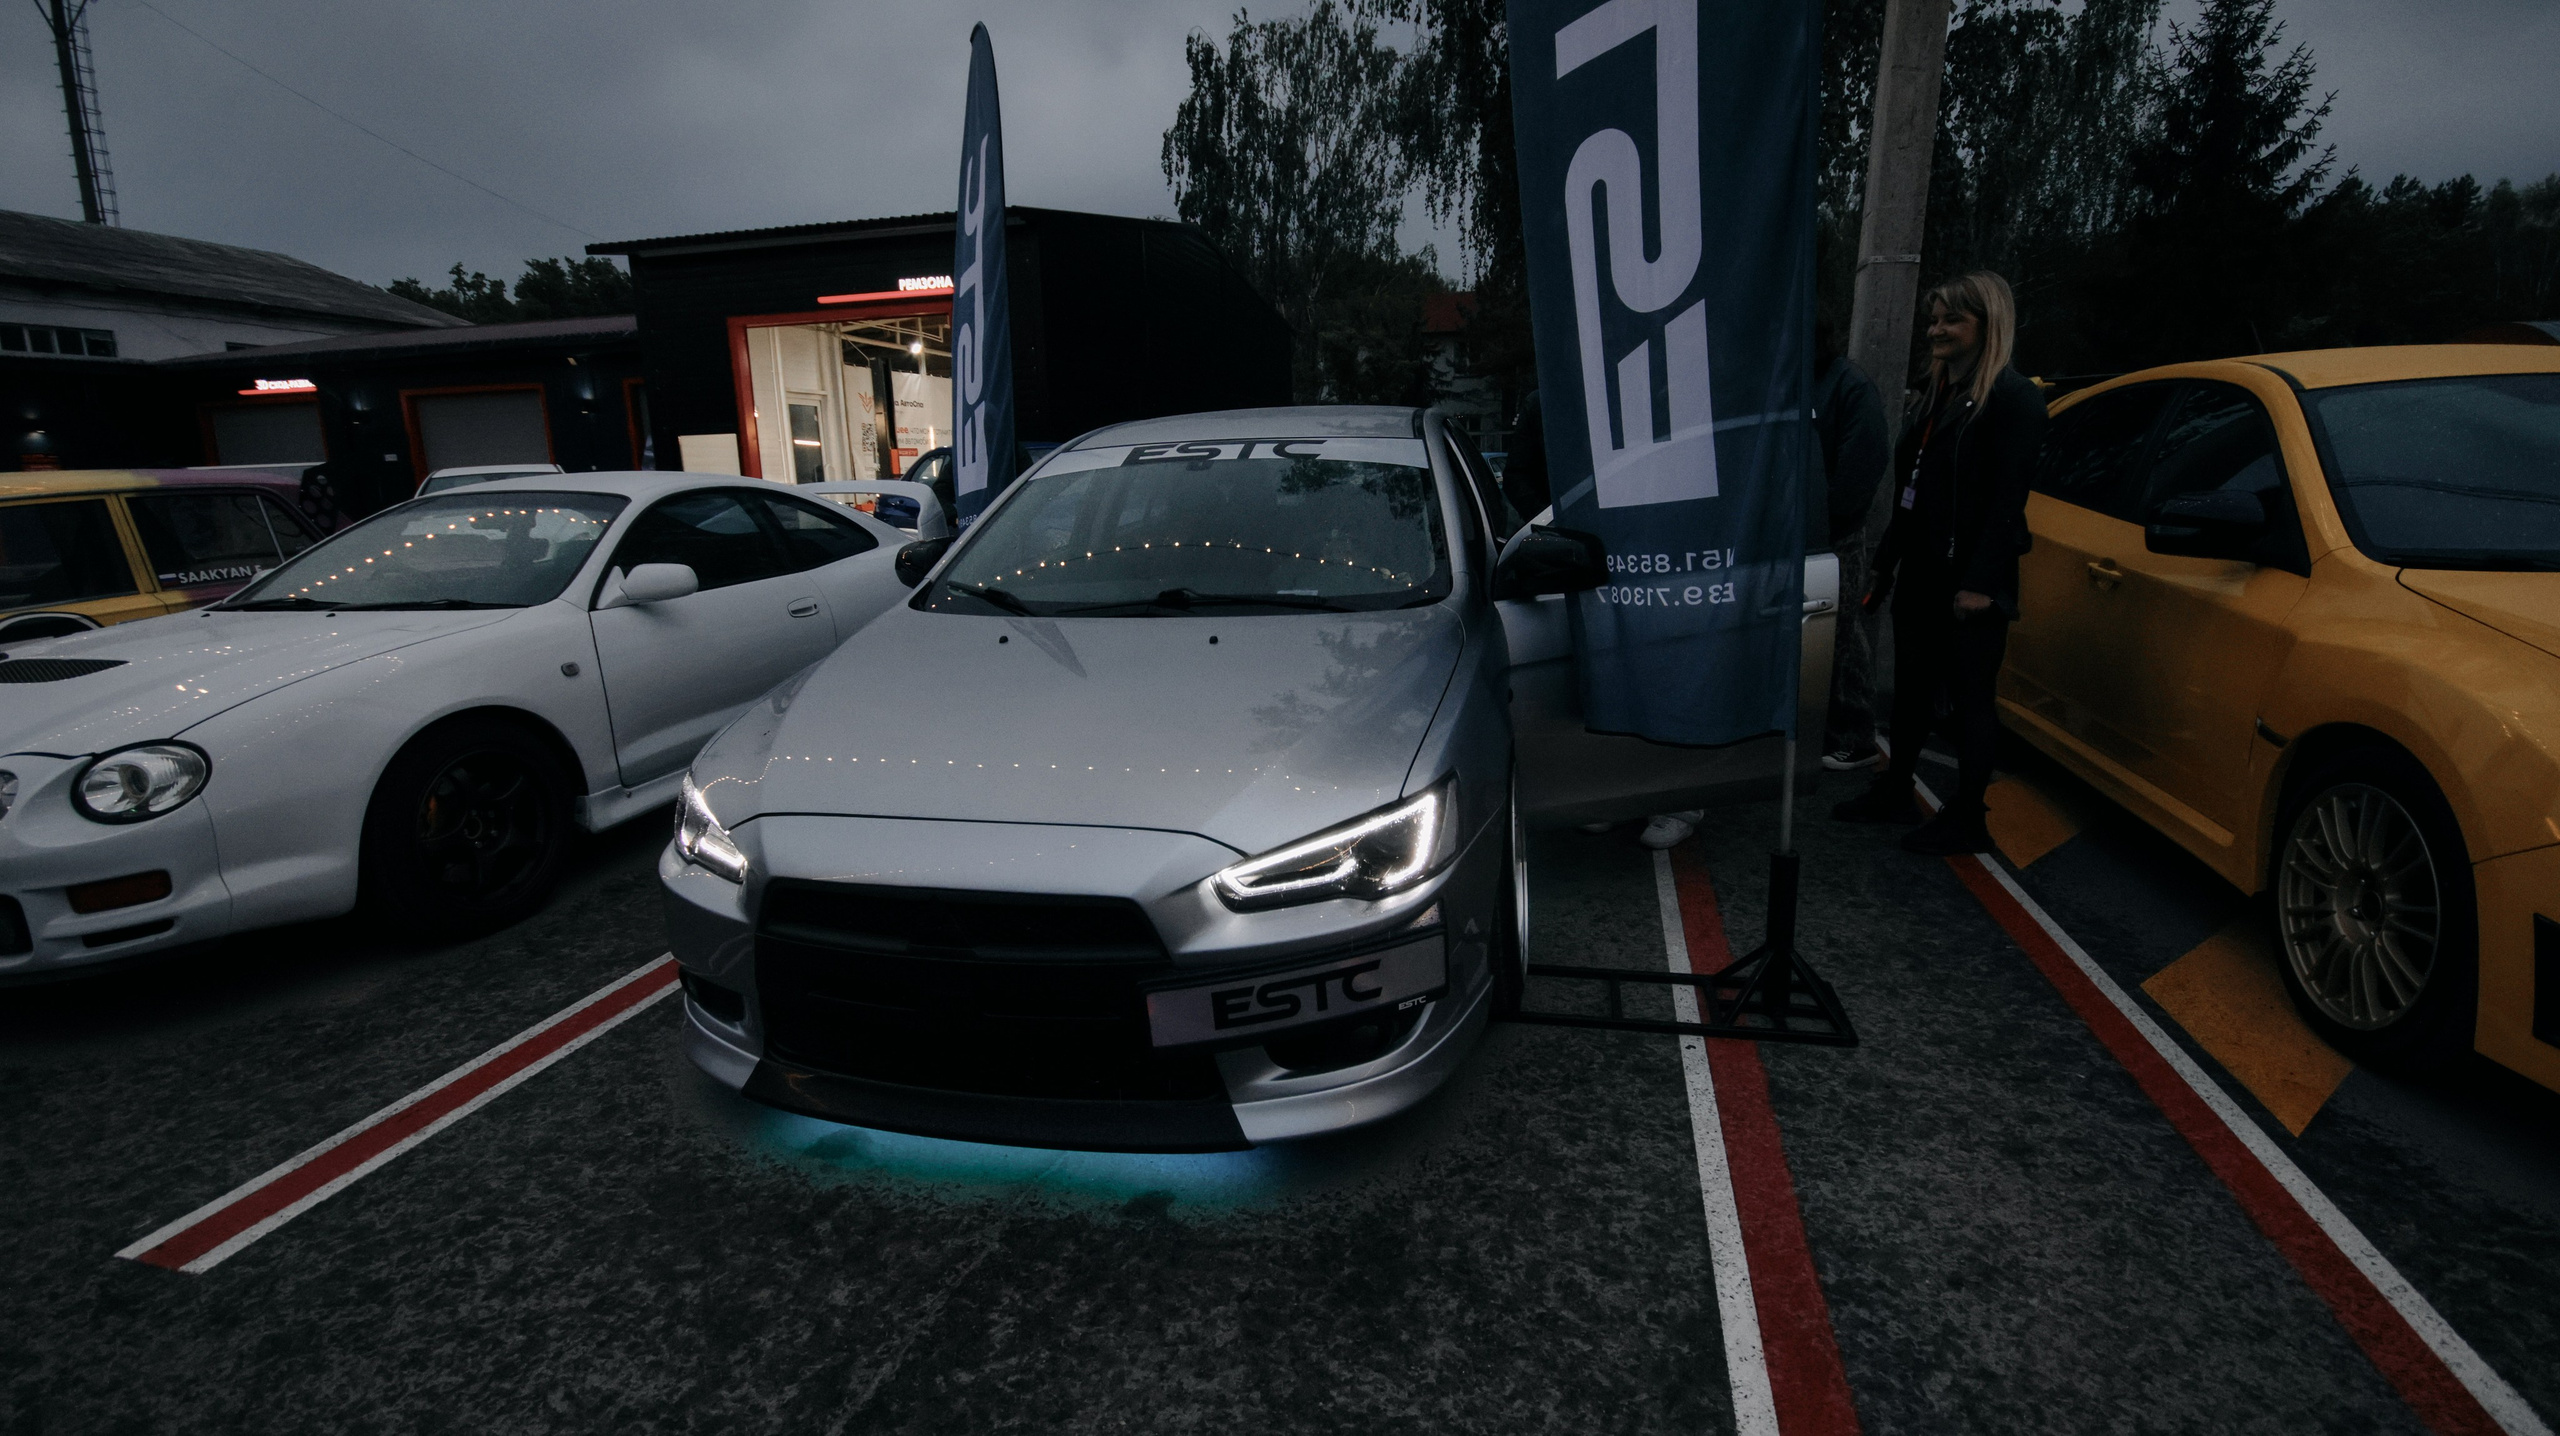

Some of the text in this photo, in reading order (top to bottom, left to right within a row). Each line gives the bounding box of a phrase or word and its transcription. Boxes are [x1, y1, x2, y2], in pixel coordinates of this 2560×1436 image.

[898, 275, 954, 291] РЕМЗОНА
[1120, 439, 1327, 467] ESTC
[178, 565, 251, 584] SAAKYAN
[1211, 959, 1383, 1030] ESTC
[1399, 995, 1427, 1010] ESTC
